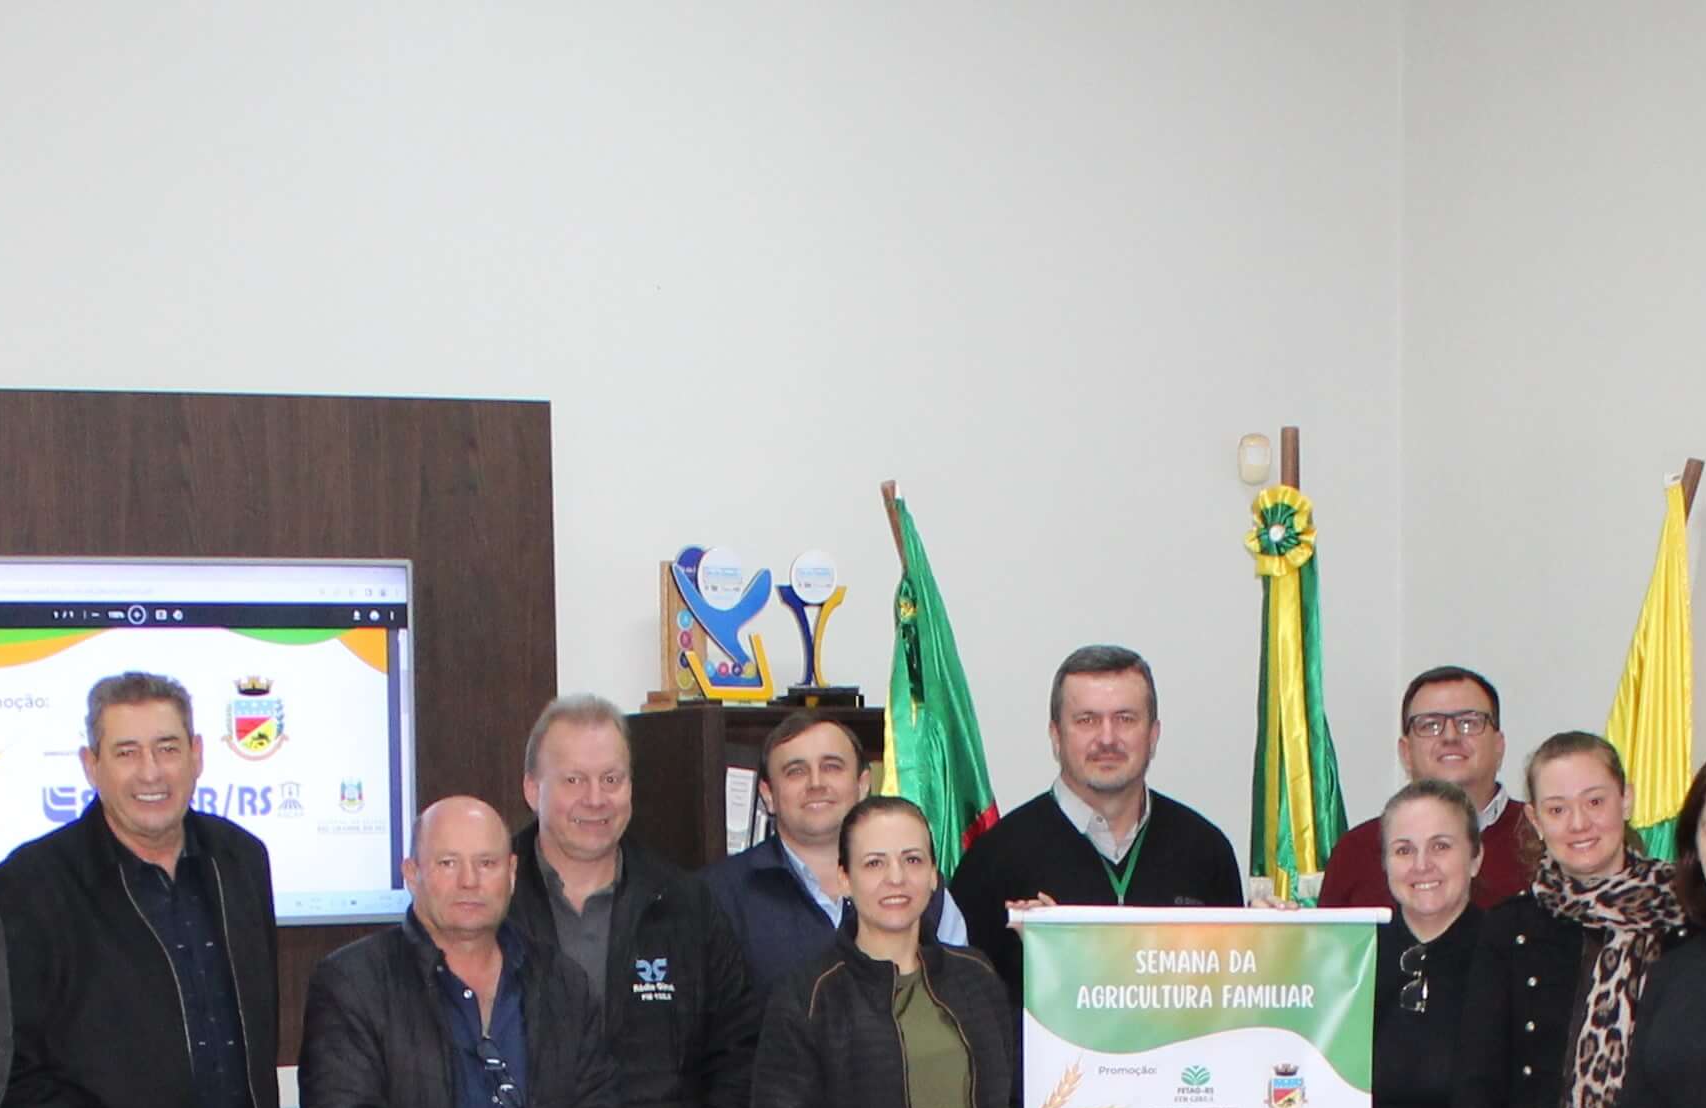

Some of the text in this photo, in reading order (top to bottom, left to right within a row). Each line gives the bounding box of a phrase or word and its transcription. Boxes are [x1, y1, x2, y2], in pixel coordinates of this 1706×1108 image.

[1135, 949, 1257, 975] SEMANA DA
[1076, 984, 1315, 1010] AGRICULTURA FAMILIAR
[1098, 1065, 1158, 1079] Promoção:
